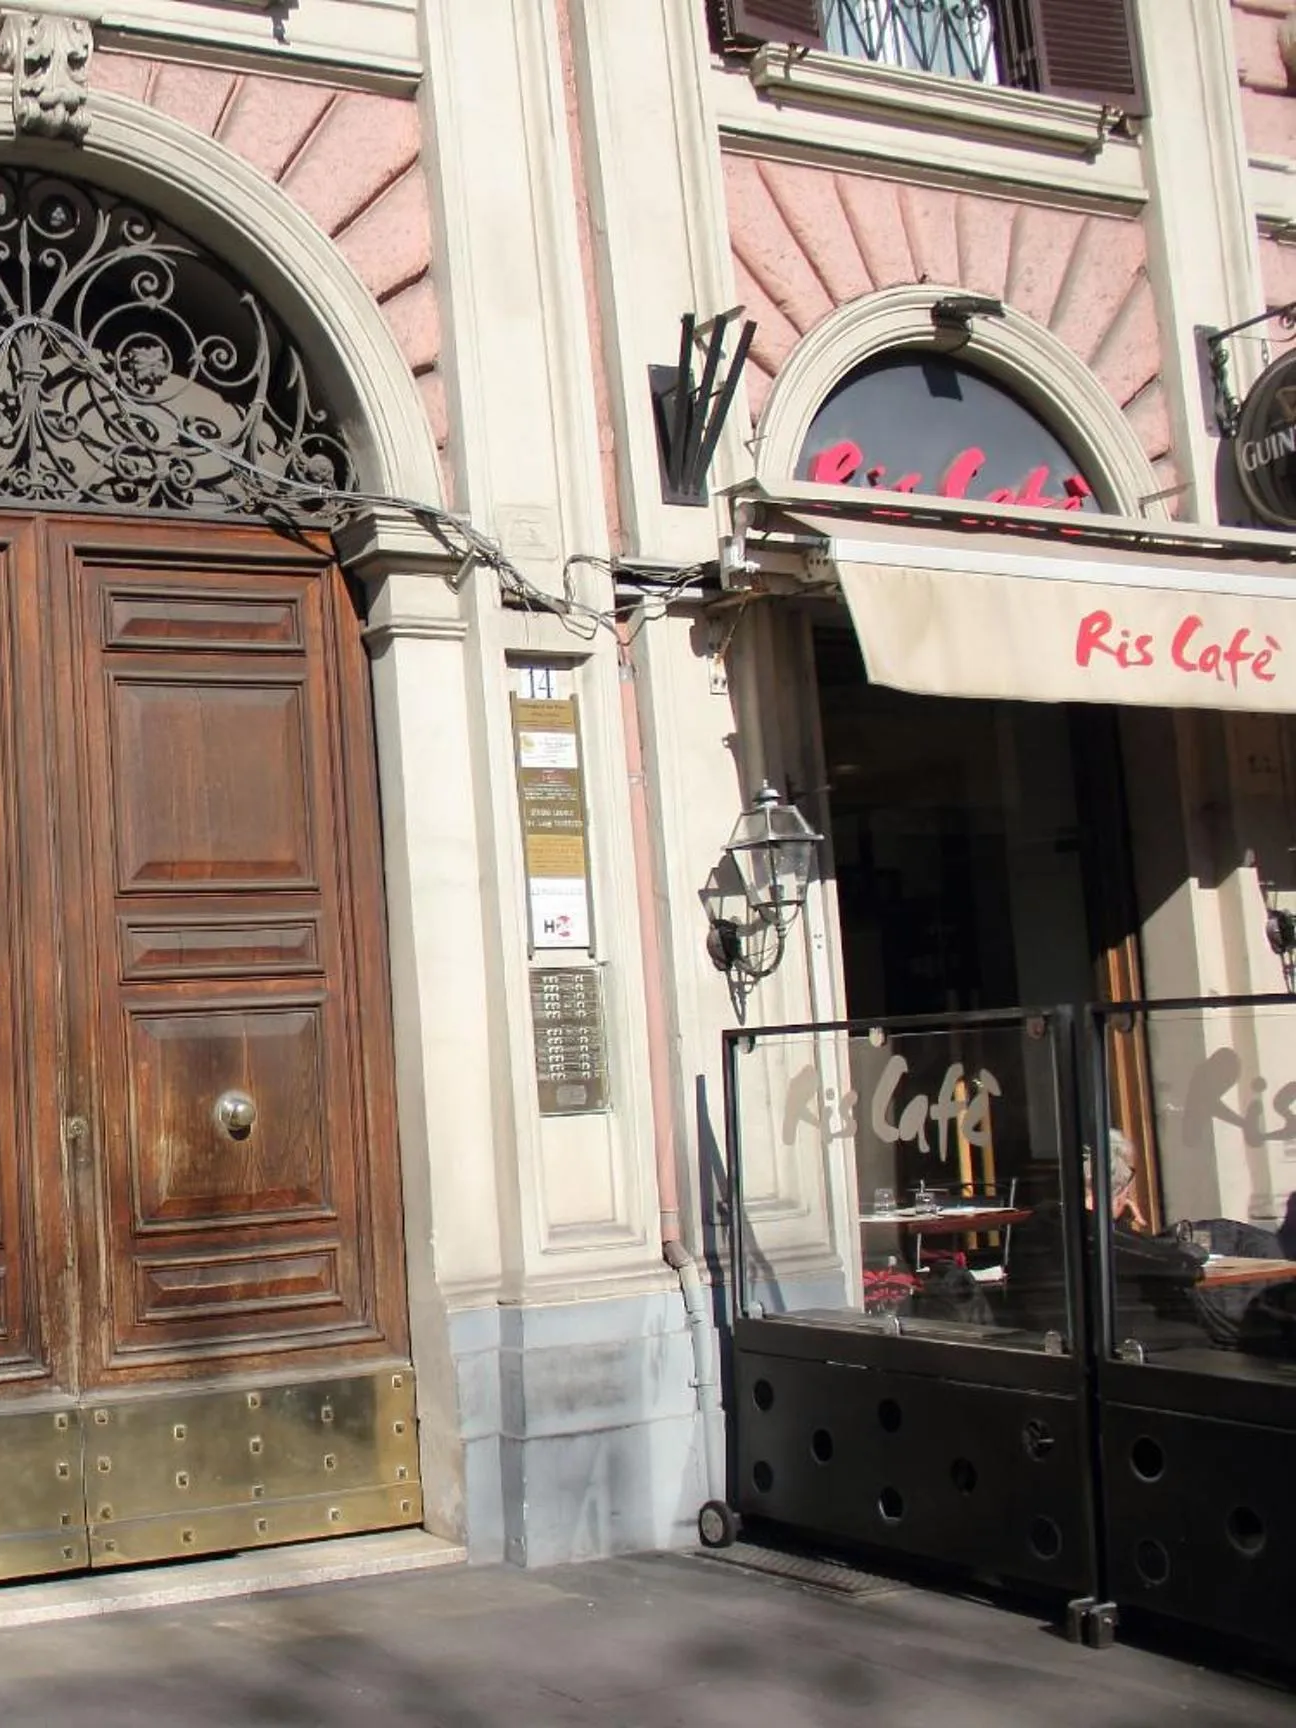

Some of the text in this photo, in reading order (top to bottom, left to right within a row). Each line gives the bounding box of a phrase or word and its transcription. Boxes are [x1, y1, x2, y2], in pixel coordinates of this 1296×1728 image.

[1242, 424, 1296, 472] GUIN
[1075, 609, 1283, 690] Ris Cafè
[782, 1063, 858, 1146] Ris
